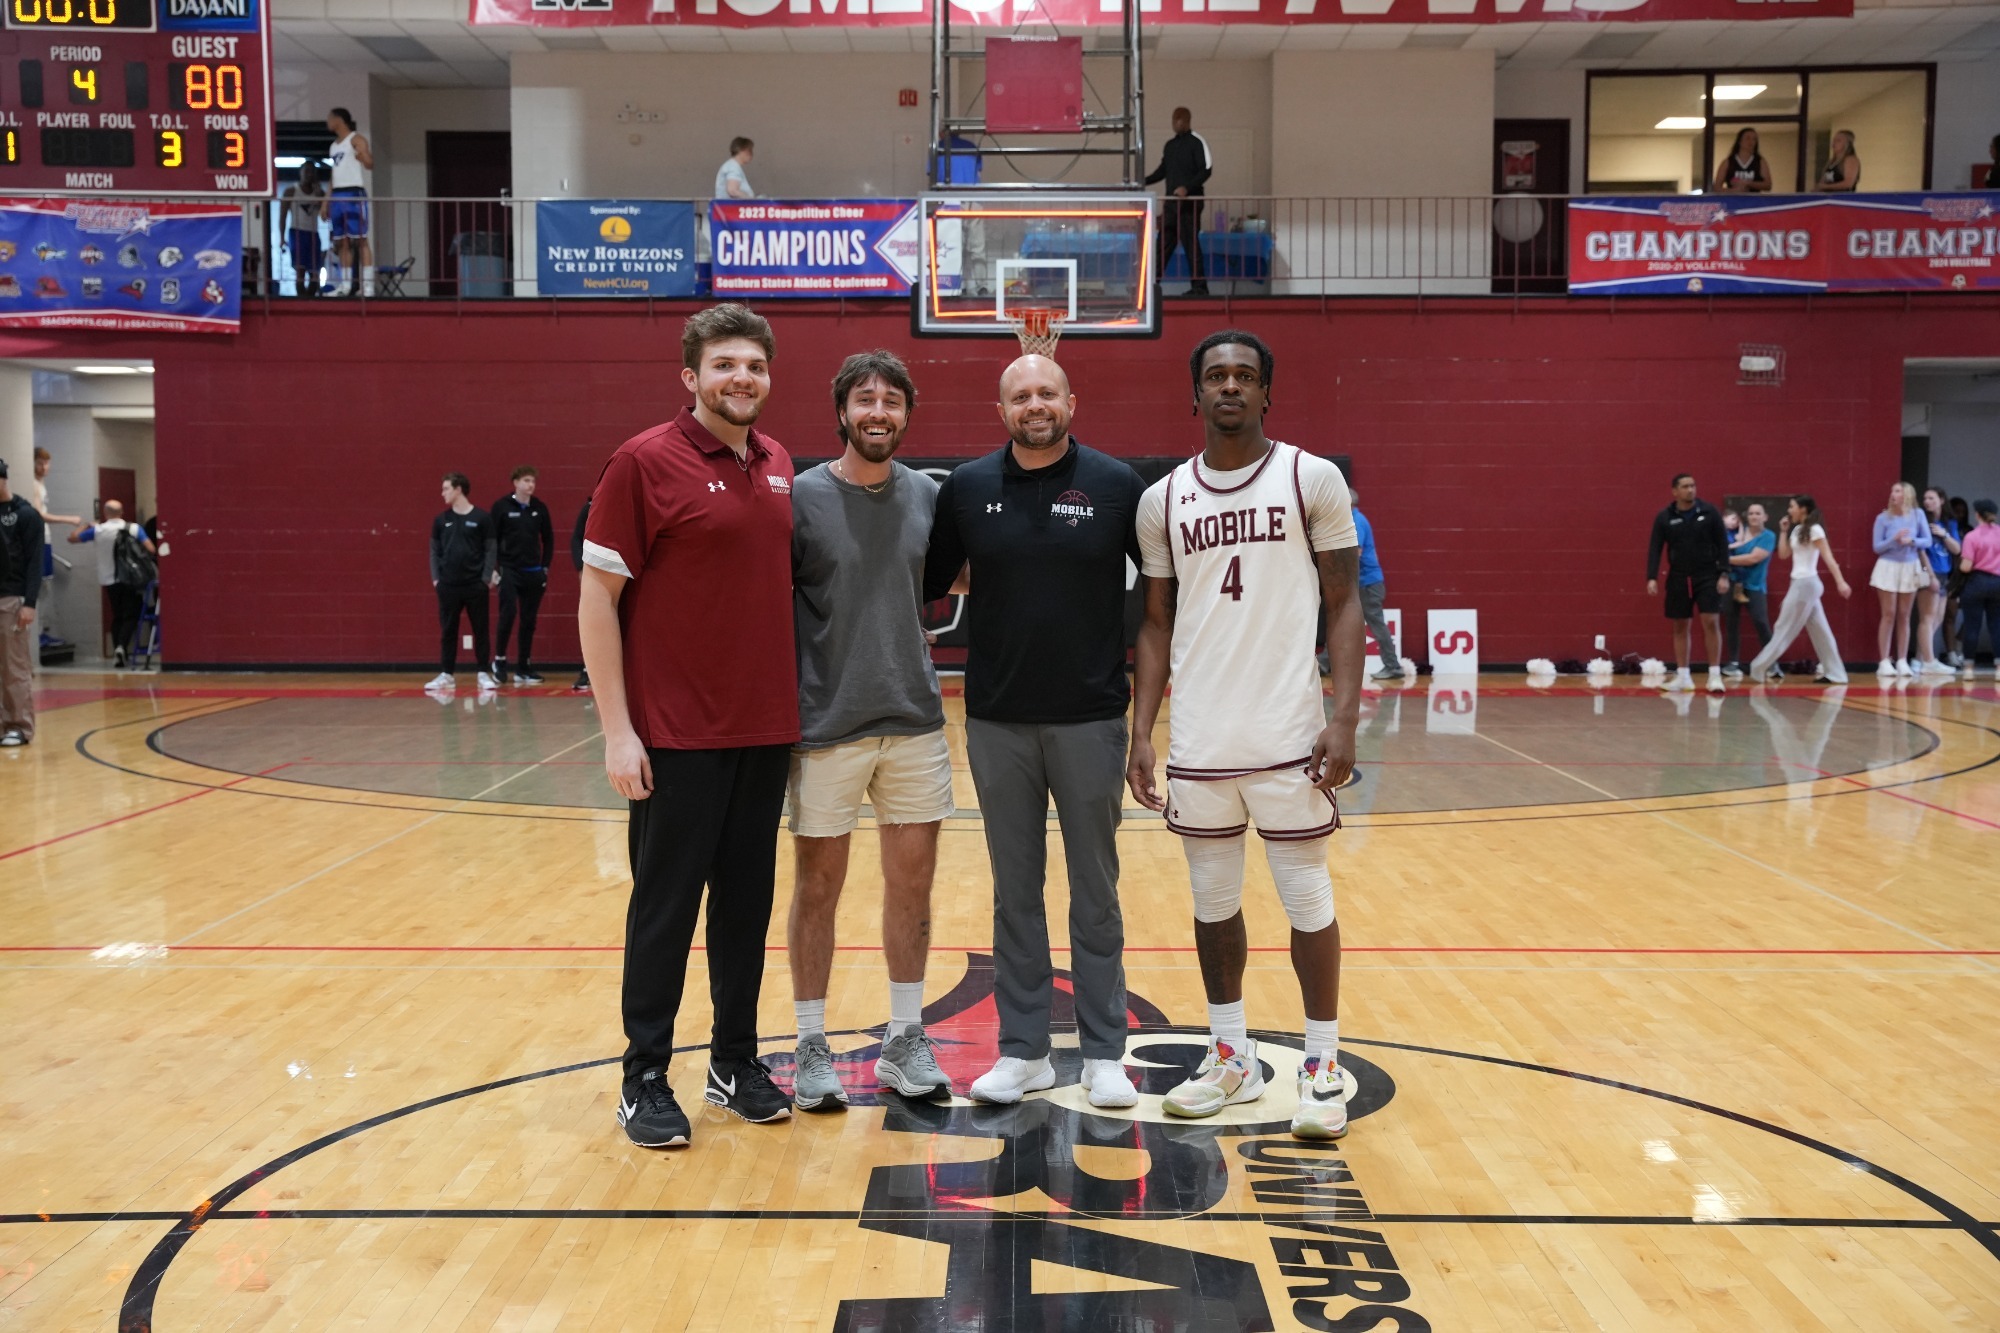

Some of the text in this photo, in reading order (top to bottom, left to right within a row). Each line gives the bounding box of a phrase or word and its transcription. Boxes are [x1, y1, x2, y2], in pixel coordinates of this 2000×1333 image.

[51, 46, 101, 62] PERIOD
[172, 36, 239, 59] GUEST
[73, 69, 96, 100] 4
[185, 65, 243, 110] 80
[37, 112, 136, 129] PLAYER FOUL
[150, 114, 189, 130] T.O.L.
[204, 115, 249, 130] FOULS
[162, 131, 182, 167] 3
[225, 132, 245, 168] 3
[66, 173, 113, 188] MATCH
[215, 174, 248, 190] WON
[590, 206, 641, 216] Sponsored By:
[739, 206, 865, 220] 2023 Competitive Cheer
[717, 229, 866, 267] CHAMPIONS
[1585, 230, 1811, 261] CHAMPIONS
[554, 261, 678, 273] CREDIT UNION
[1685, 261, 1746, 271] VOLLEYBALL
[583, 277, 649, 291] NewHCU.org
[716, 275, 888, 289] Southern States Athletic Conference
[1051, 503, 1094, 517] MOBILE
[1180, 507, 1286, 556] MOBILE
[1220, 555, 1244, 601] 4
